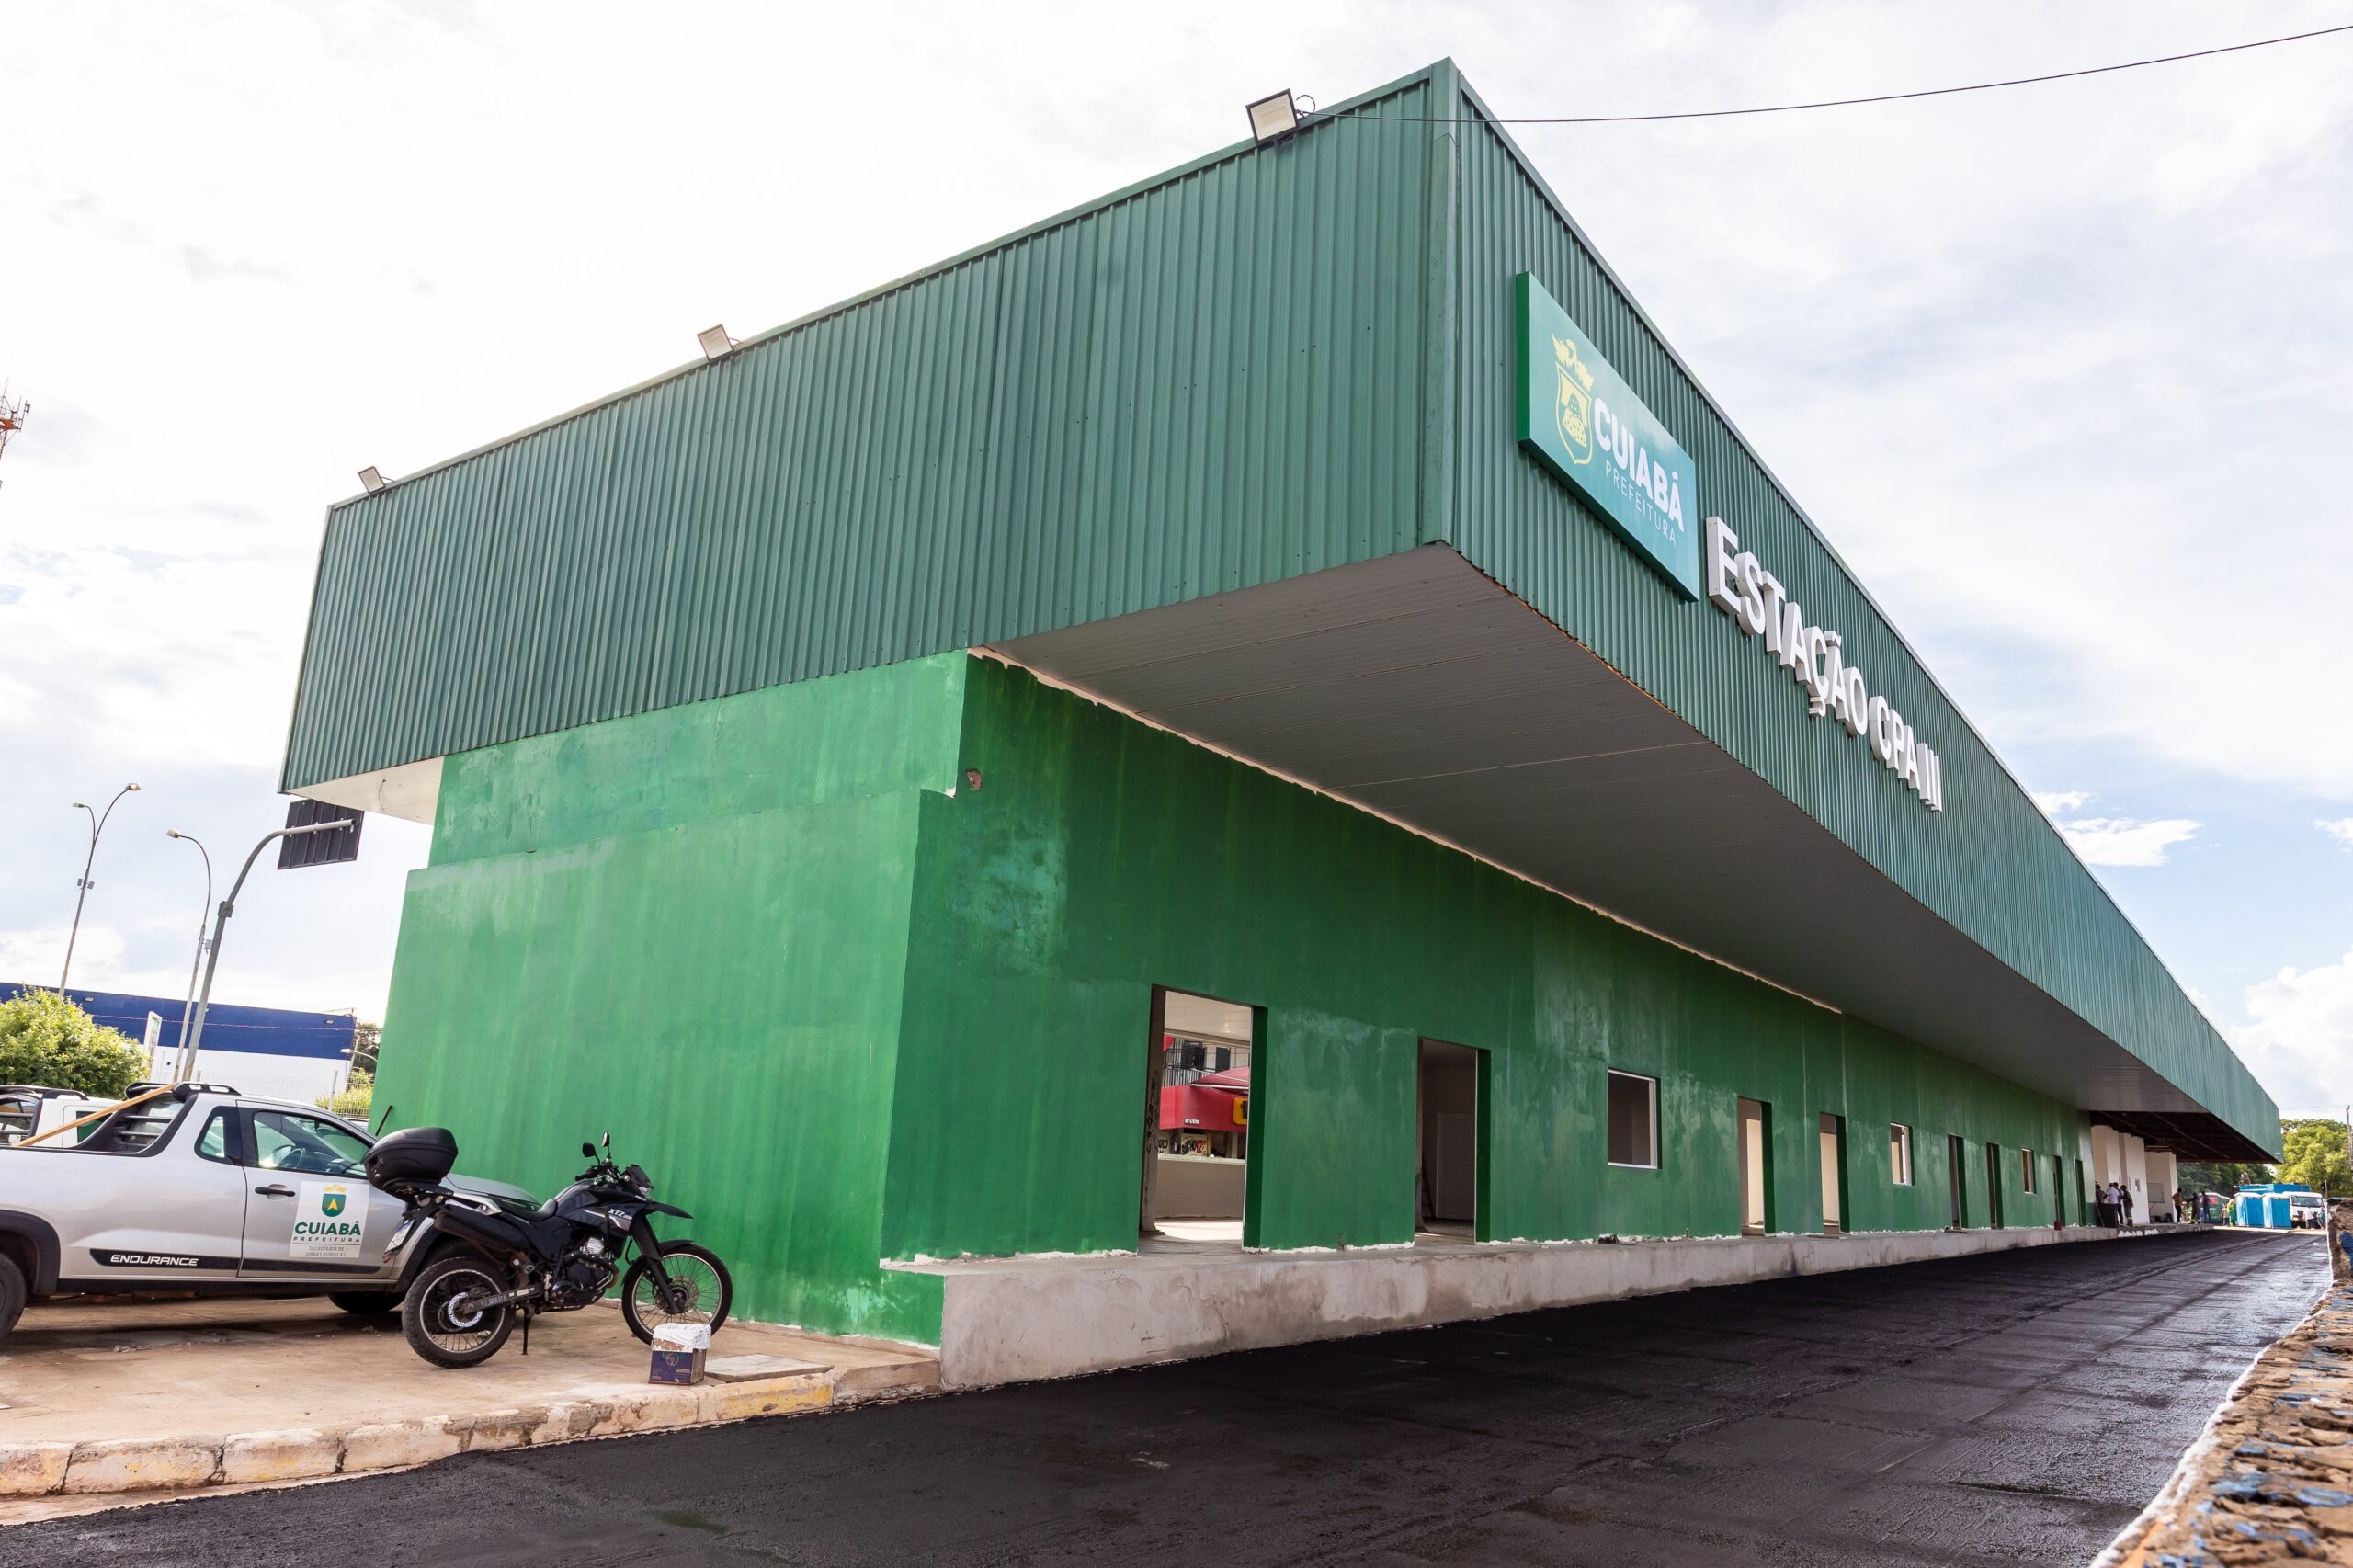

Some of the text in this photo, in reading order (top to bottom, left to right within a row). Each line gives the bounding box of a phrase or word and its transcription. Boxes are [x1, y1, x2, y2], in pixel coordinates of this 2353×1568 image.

[1594, 397, 1685, 533] CUIABÁ
[1605, 459, 1677, 547] PREFEITURA
[1706, 516, 1869, 736] ESTAÇÃO
[1868, 695, 1921, 790] CPA
[294, 1221, 361, 1236] CUIABÁ
[110, 1254, 199, 1267] ENDURANCE
[480, 1293, 509, 1307] YAMAHA
